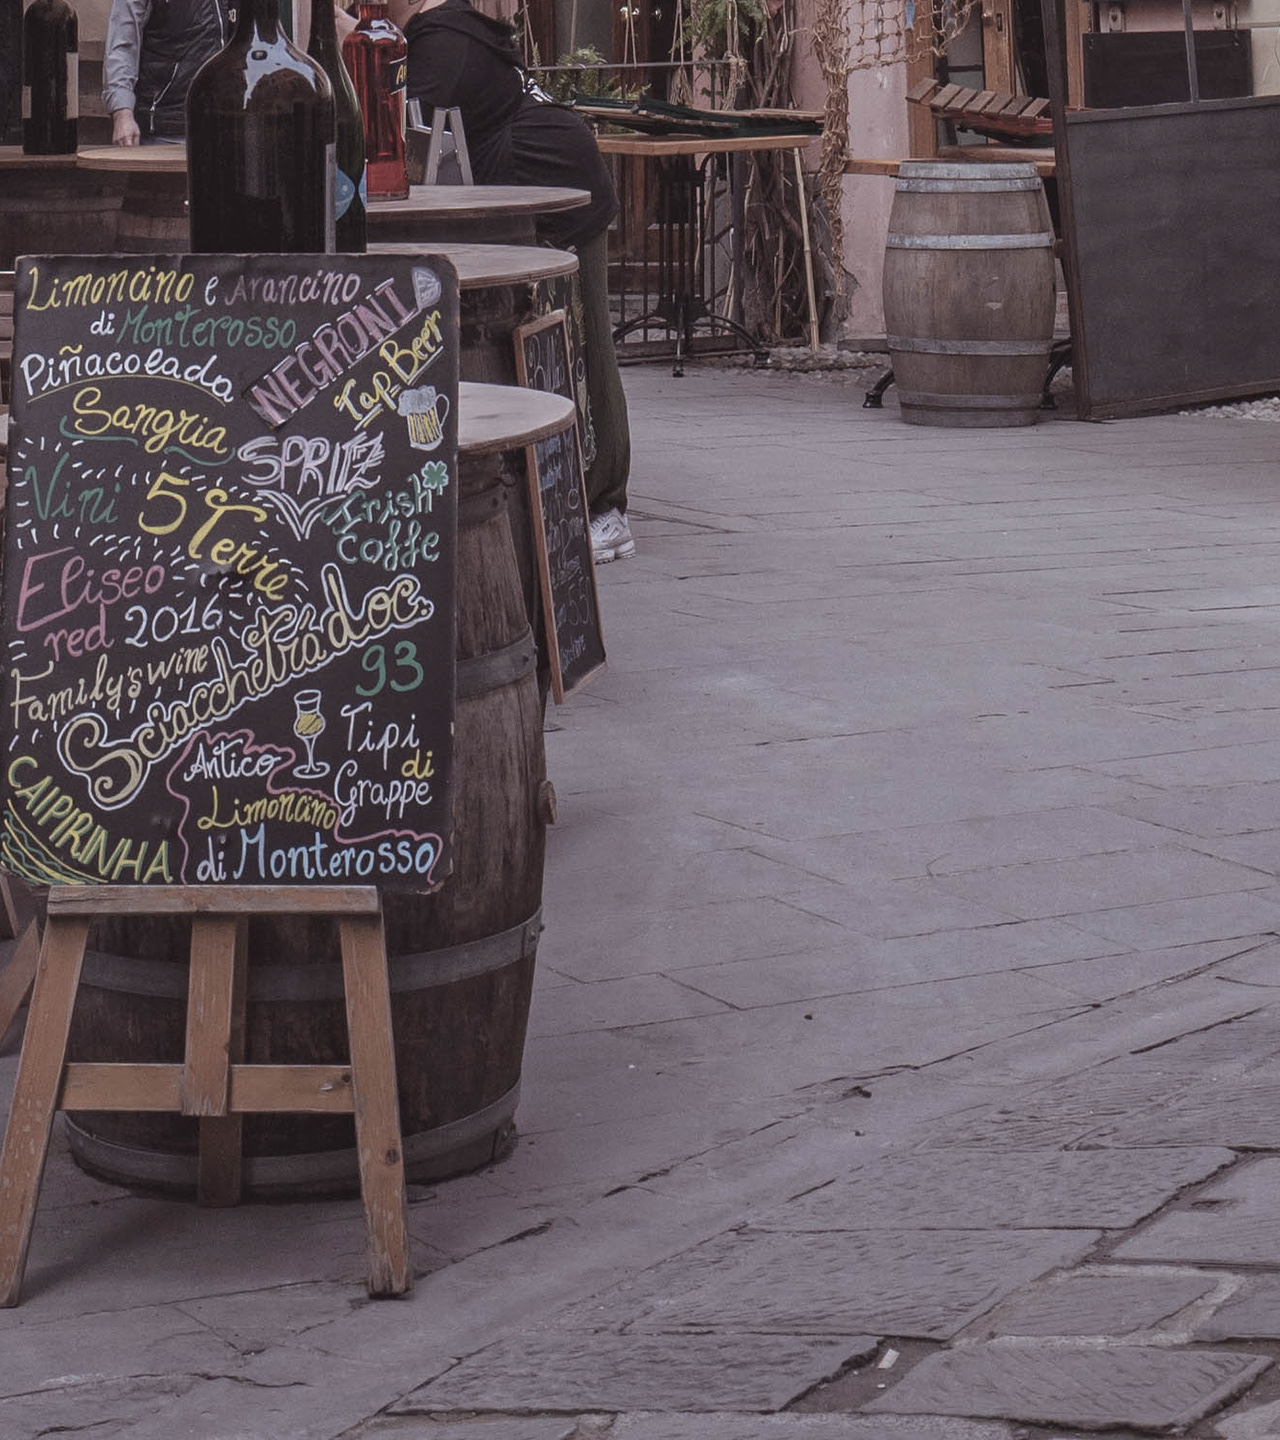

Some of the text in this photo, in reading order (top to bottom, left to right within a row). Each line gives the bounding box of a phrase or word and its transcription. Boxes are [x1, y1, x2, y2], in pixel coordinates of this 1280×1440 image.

[26, 266, 361, 311] Limoncino e Arancino
[90, 304, 297, 348] di Monterosso
[251, 279, 418, 428] NEGRONI
[333, 310, 443, 421] Tap Beer
[73, 386, 228, 454] Sangria
[24, 452, 290, 601] Vini 5 Terre
[321, 473, 433, 535] Irish
[336, 520, 440, 572] Coffe
[17, 546, 166, 632] Eliseo
[44, 593, 223, 661] red 2016
[10, 643, 209, 729] Family's wine
[355, 641, 424, 696] 93
[183, 738, 282, 782] Antico
[340, 702, 420, 771] Tipi
[401, 749, 435, 779] di
[196, 785, 337, 830] Limoncino
[334, 760, 433, 827] Grappe
[196, 822, 435, 882] di Monterosso
